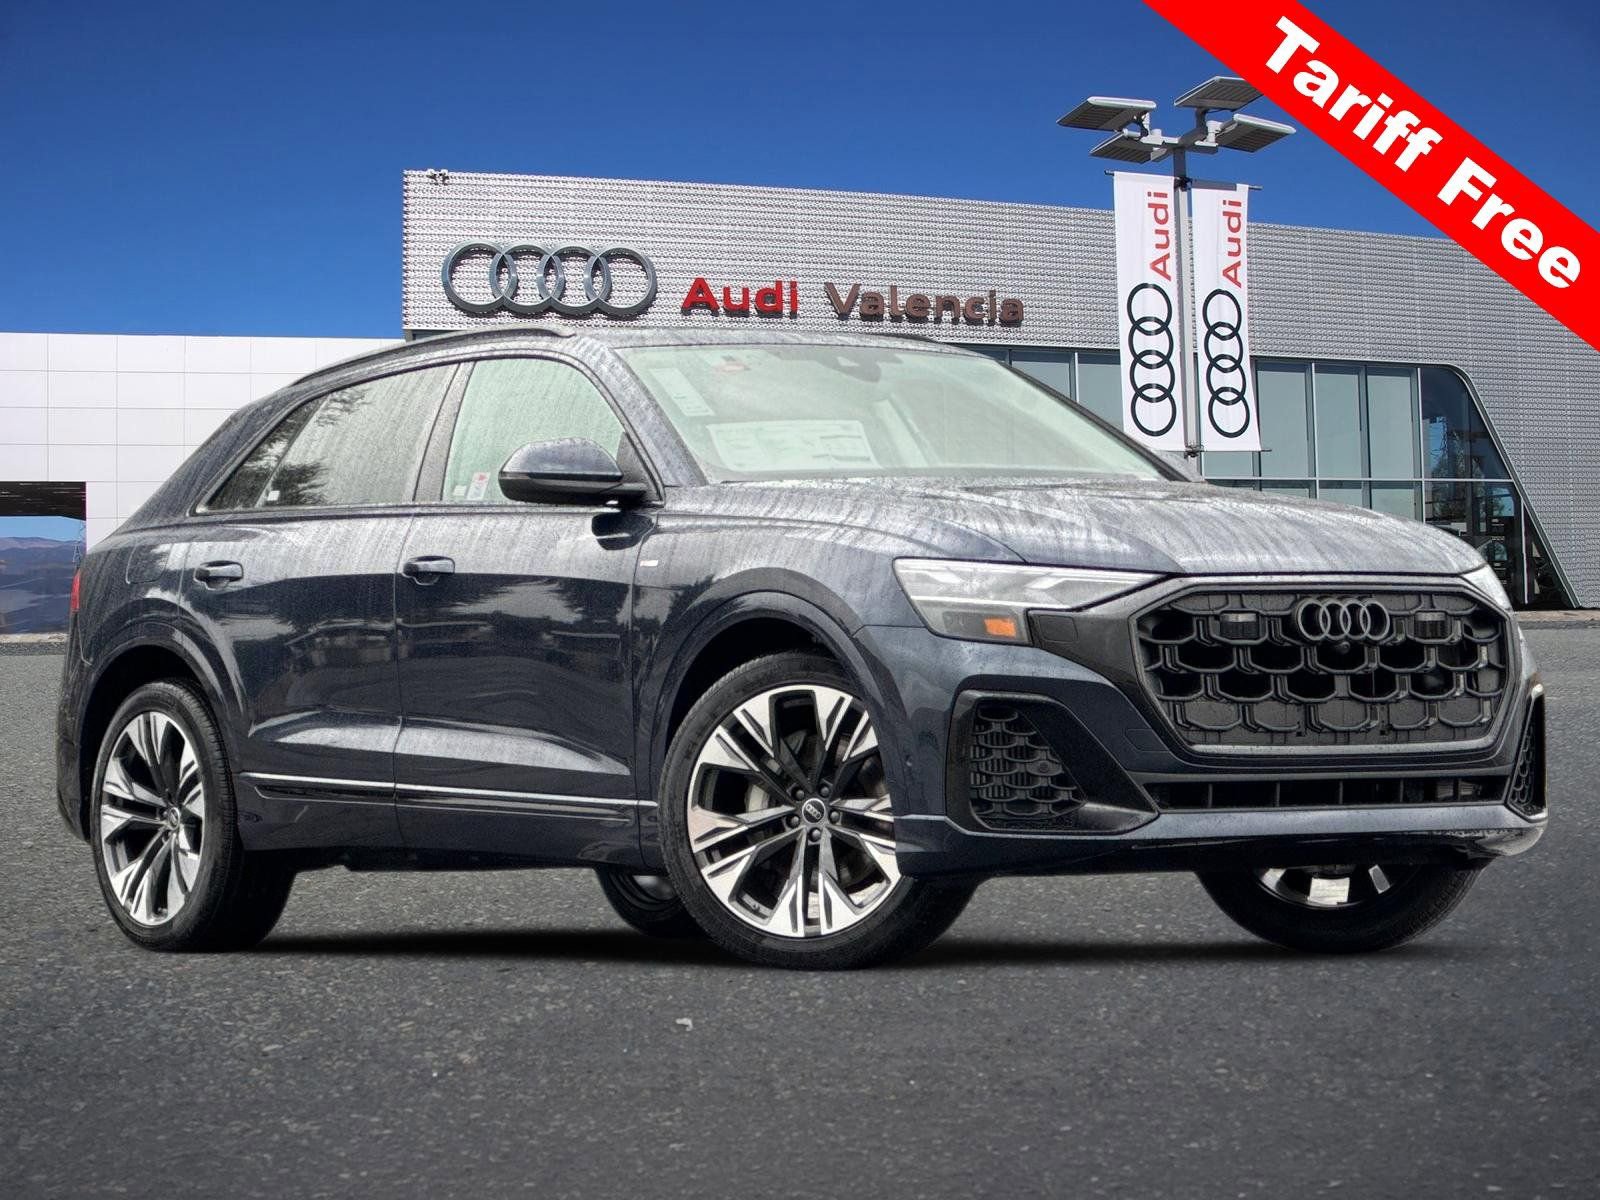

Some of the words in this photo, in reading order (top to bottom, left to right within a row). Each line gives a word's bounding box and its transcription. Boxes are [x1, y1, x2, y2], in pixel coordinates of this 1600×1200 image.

[1148, 190, 1171, 281] Audi
[1223, 200, 1242, 288] Audi
[681, 278, 799, 316] Audi
[825, 283, 1024, 326] Valencia
